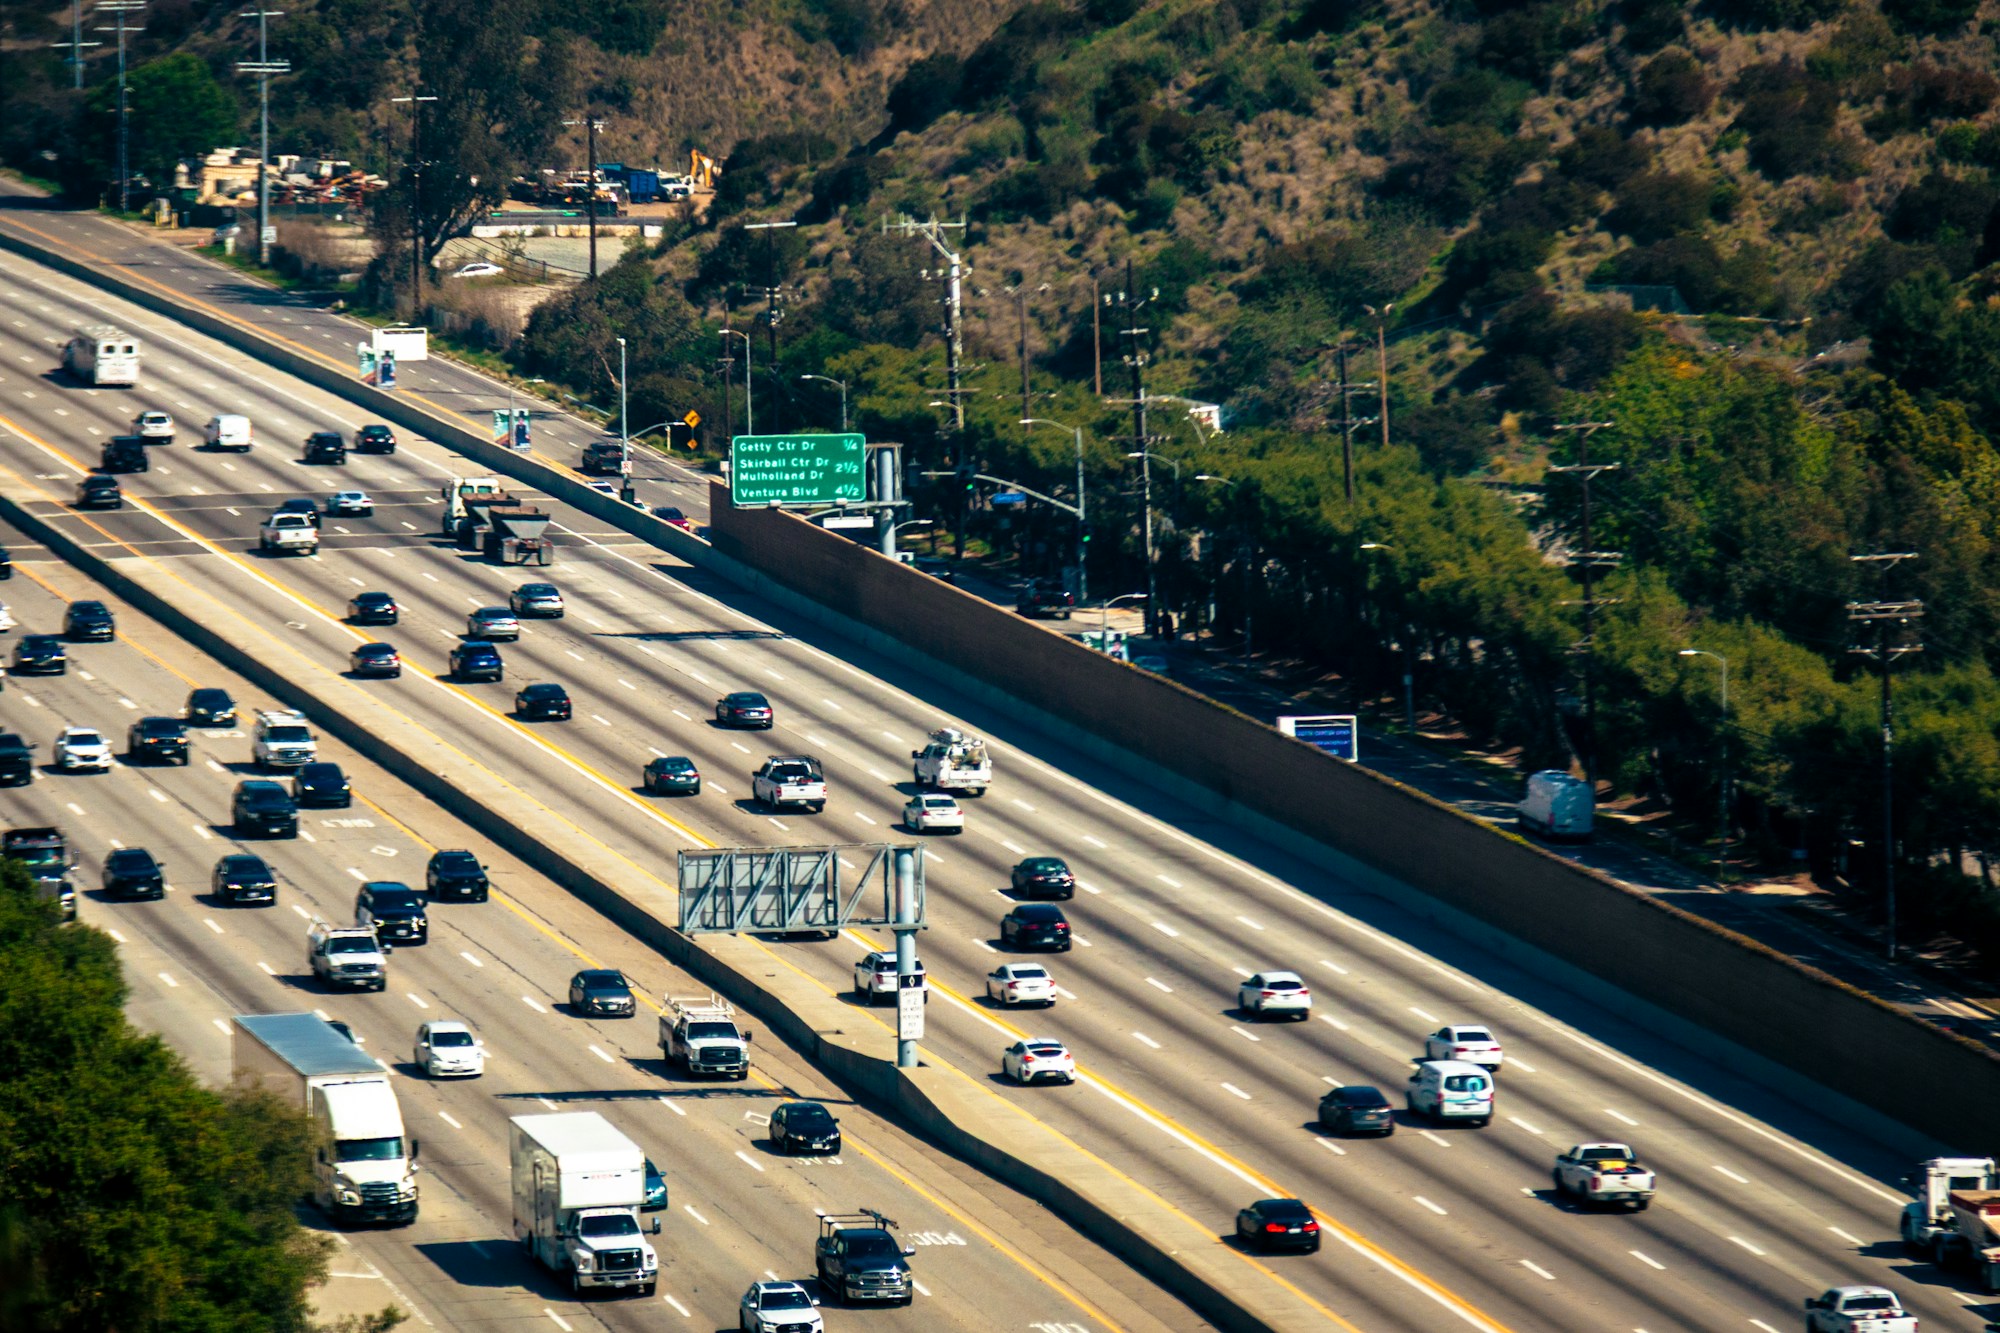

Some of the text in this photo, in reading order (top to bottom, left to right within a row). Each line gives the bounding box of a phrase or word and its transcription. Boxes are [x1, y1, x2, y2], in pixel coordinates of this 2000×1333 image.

[740, 441, 772, 453] Getty
[777, 441, 796, 451] Ctr
[802, 441, 816, 450] Dr
[740, 457, 829, 468] Skirball Ctr Dr
[740, 470, 824, 481] Mulholland Dr
[741, 487, 787, 498] Ventura
[793, 487, 818, 496] Blvd
